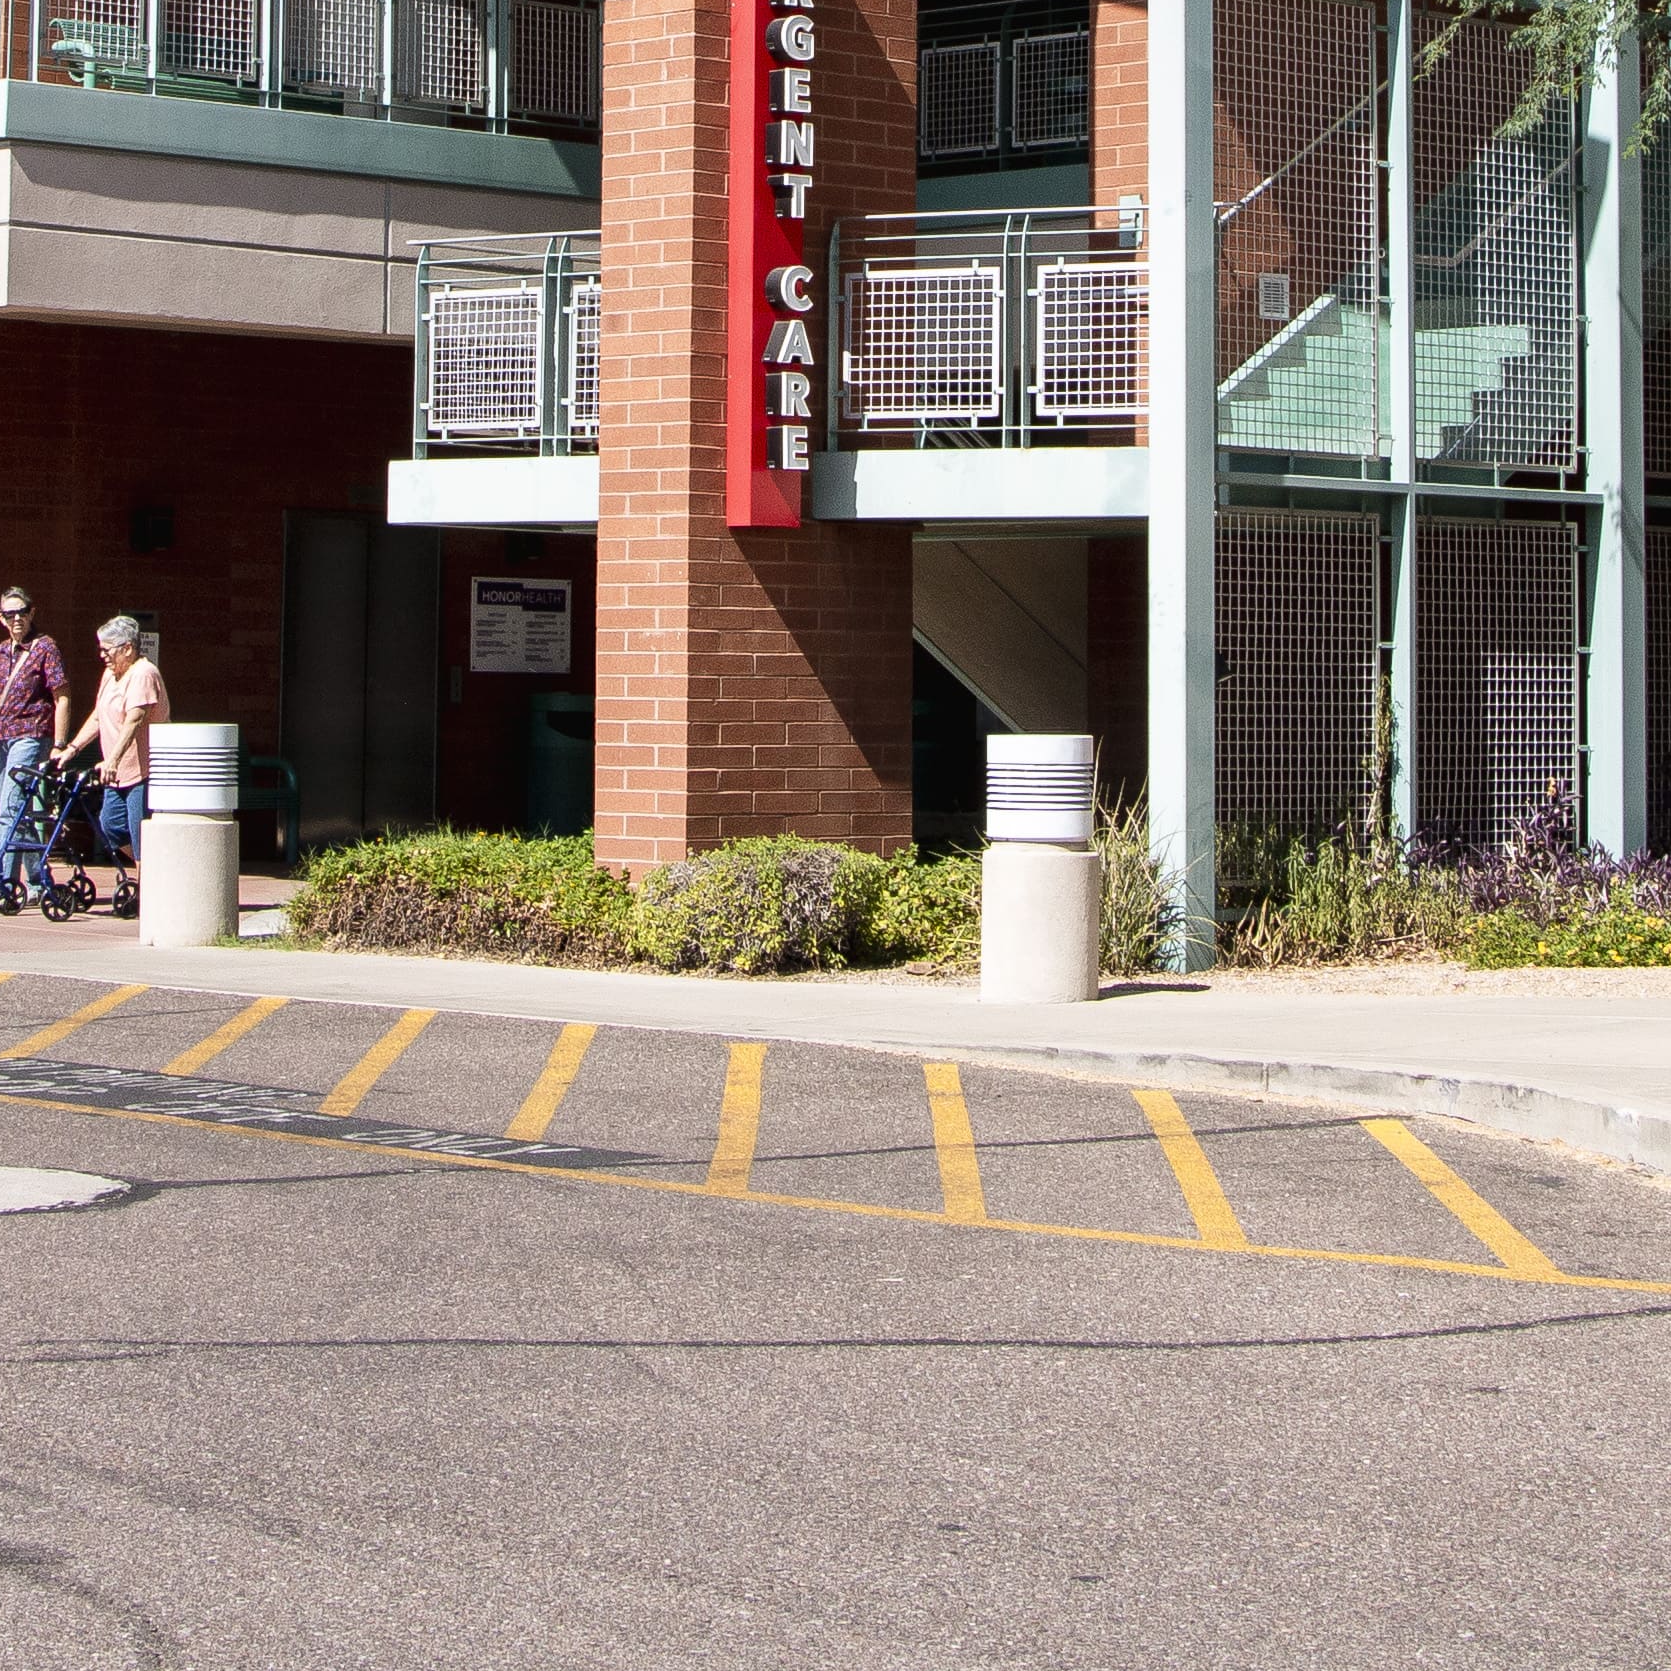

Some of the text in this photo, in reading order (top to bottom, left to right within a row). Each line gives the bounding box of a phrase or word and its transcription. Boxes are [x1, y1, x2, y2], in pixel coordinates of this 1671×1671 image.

[773, 264, 814, 471] CARE
[482, 591, 561, 604] HONORHEALTH
[31, 1068, 307, 1101] PARKING
[124, 1100, 343, 1123] OFF
[342, 1129, 582, 1157] ONLY
